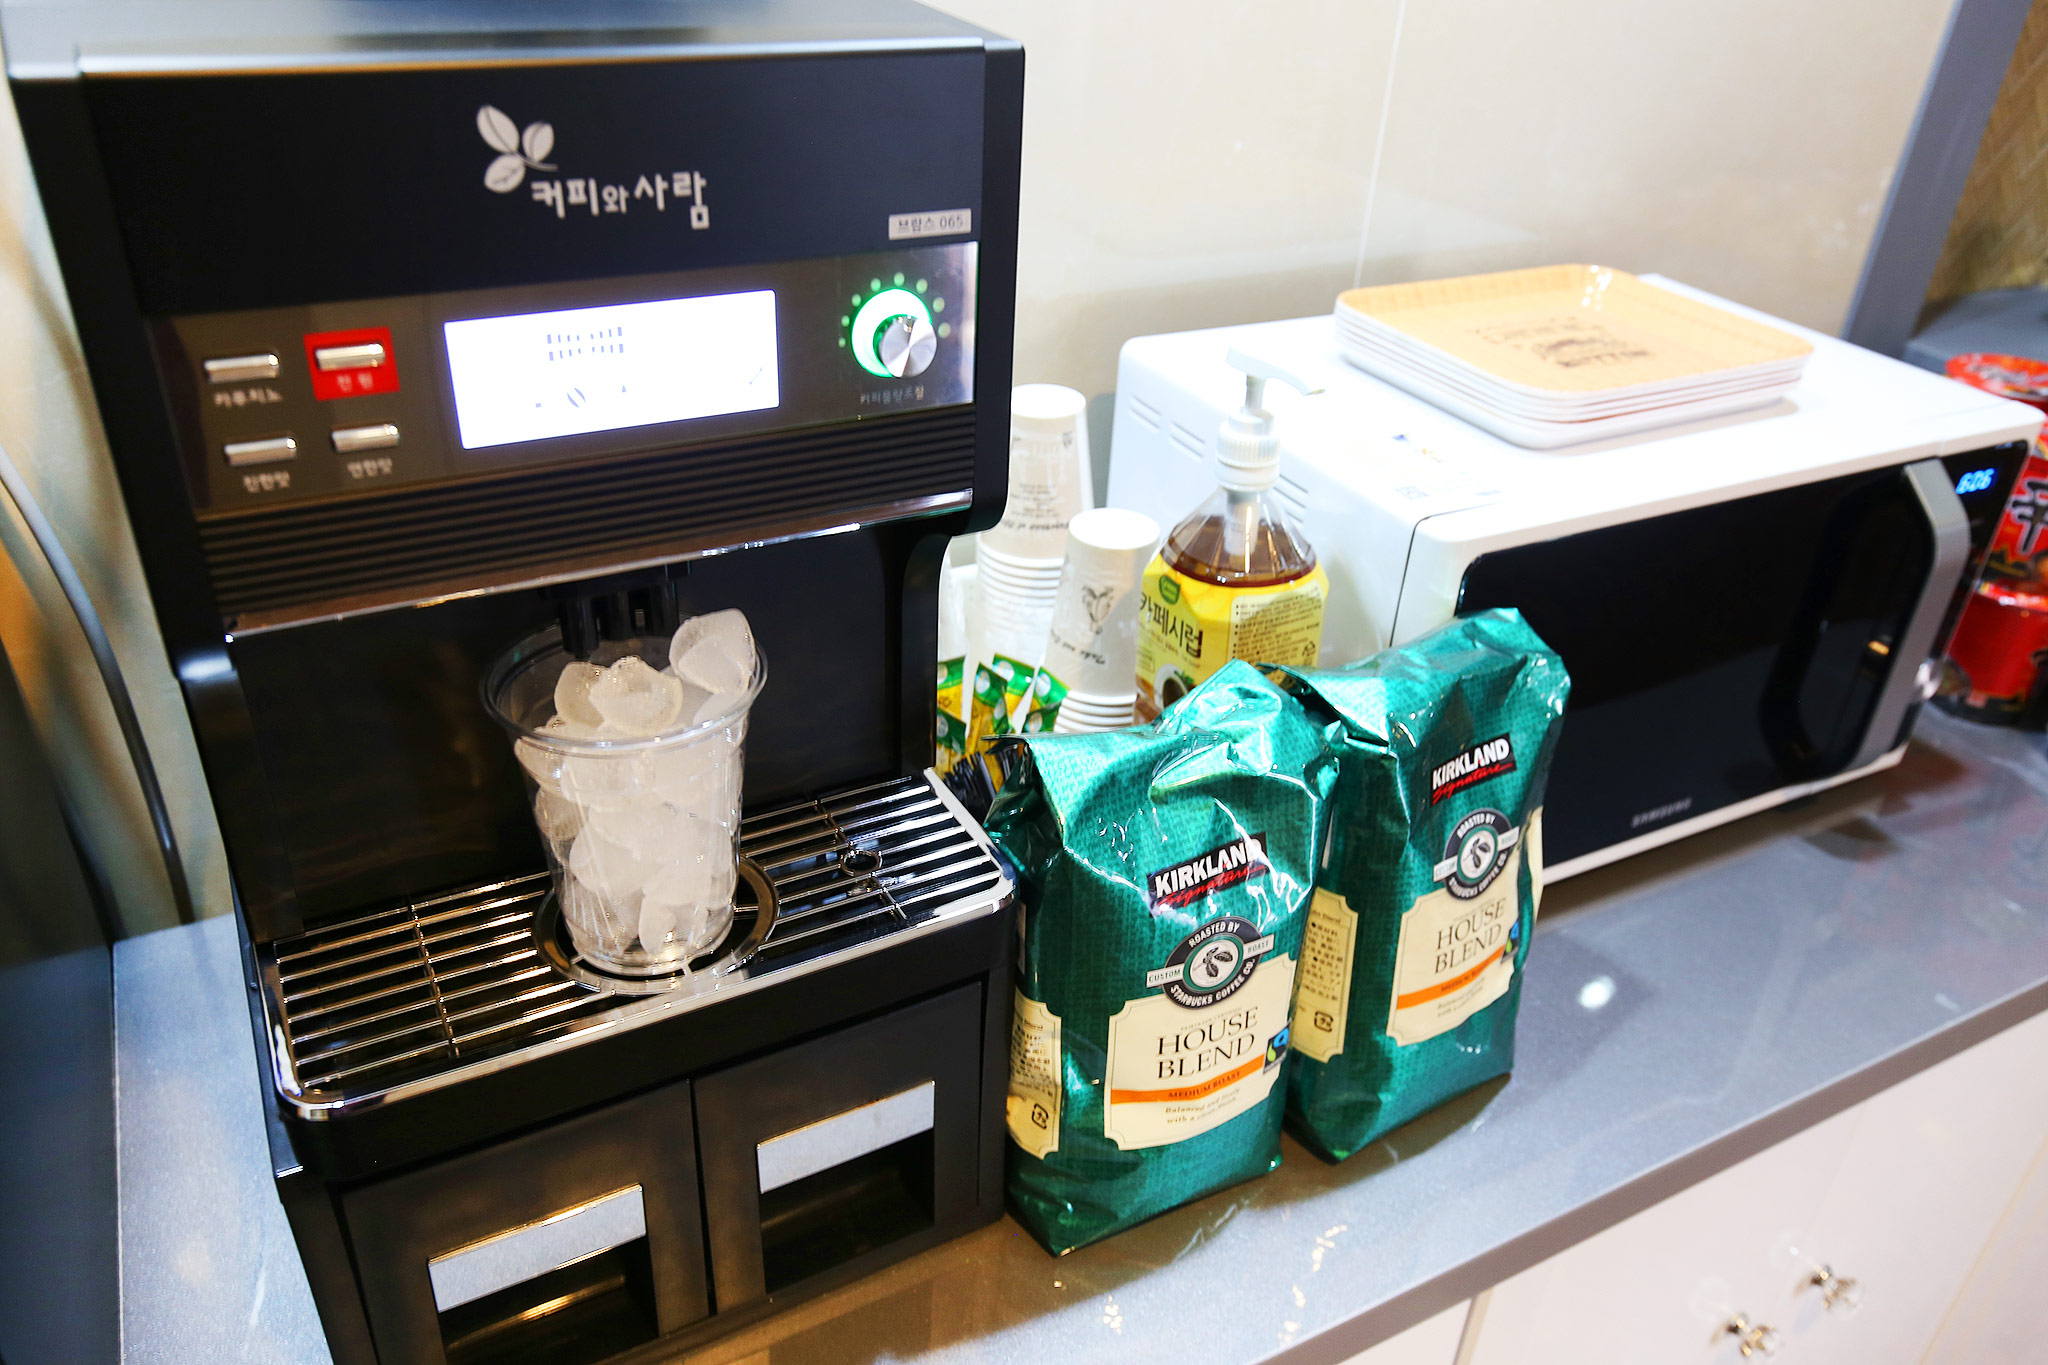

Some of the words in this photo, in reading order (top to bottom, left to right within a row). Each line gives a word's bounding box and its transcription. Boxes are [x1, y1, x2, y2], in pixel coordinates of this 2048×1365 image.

[1432, 762, 1514, 806] Signature
[1433, 738, 1511, 791] KIRKLAND
[1486, 813, 1497, 825] BY
[1188, 921, 1226, 948] ROASTED
[1227, 921, 1240, 934] BY
[1437, 898, 1507, 951] HOUSE
[1435, 923, 1502, 975] BLEND
[1148, 969, 1182, 983] CUSTOM
[1170, 984, 1213, 1008] STARBUCKS
[1215, 976, 1245, 1001] COFFEE
[1158, 1006, 1259, 1056] HOUSE
[1158, 1032, 1256, 1079] BLEND
[1168, 1084, 1211, 1098] MEDIUM
[1213, 1071, 1240, 1088] ROAST
